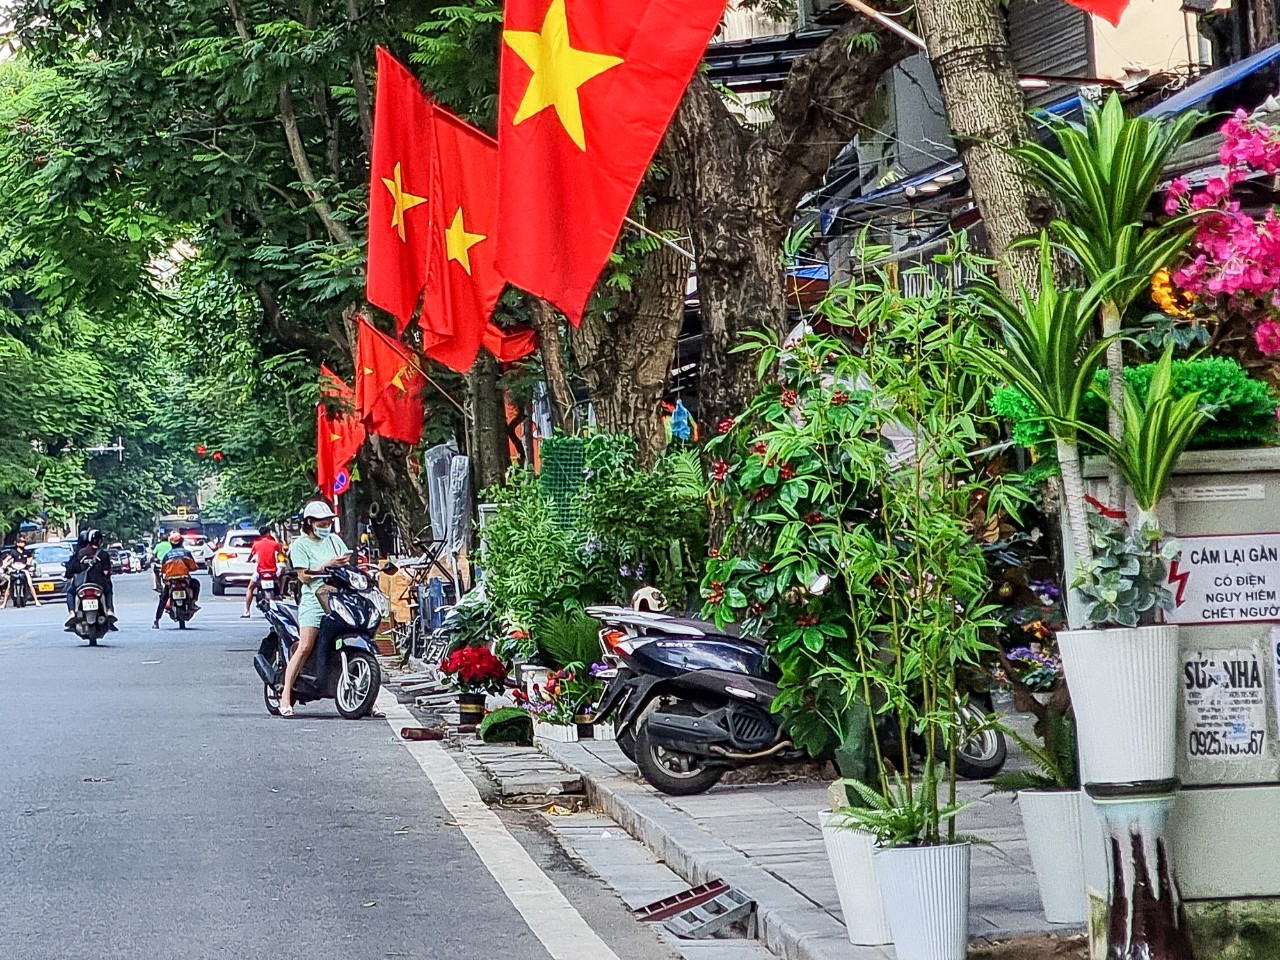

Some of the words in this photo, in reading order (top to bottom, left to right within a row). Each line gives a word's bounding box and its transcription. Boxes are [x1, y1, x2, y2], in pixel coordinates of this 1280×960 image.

[1224, 549, 1245, 567] LẠI
[1214, 572, 1233, 587] CÓ
[1236, 572, 1266, 588] ĐIỆN
[1205, 591, 1242, 603] NGUY
[1240, 603, 1280, 618] NGƯỜ
[1222, 653, 1263, 689] NHÀ
